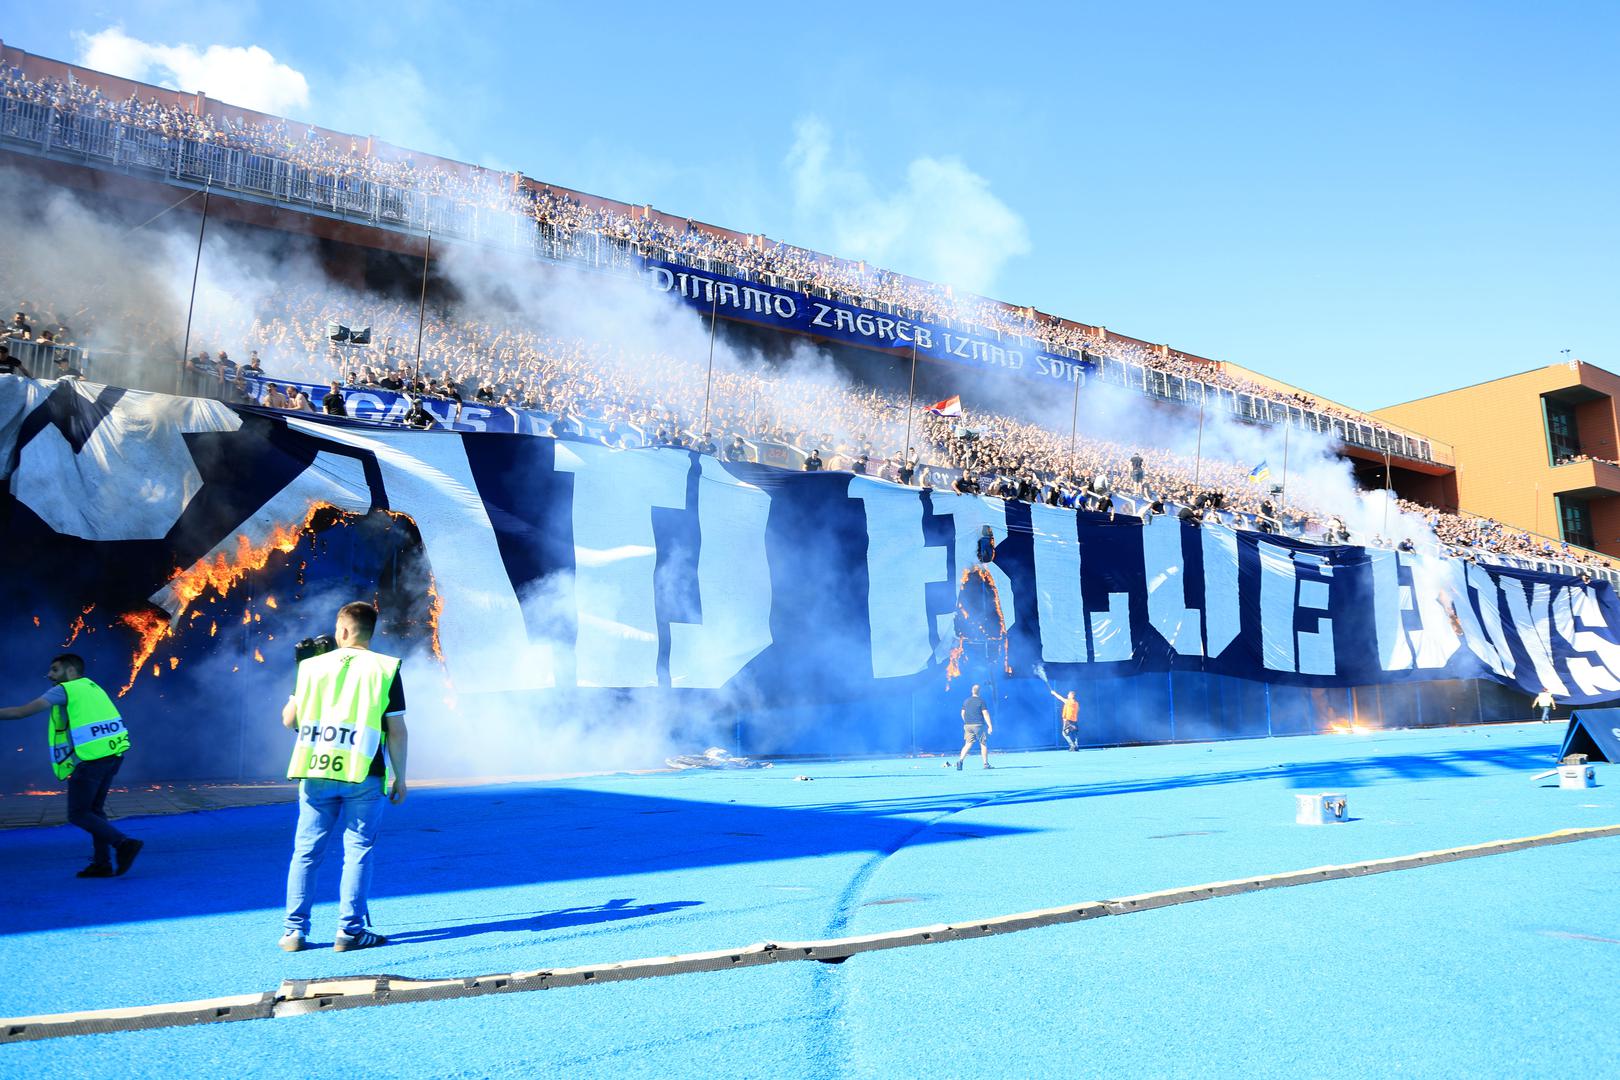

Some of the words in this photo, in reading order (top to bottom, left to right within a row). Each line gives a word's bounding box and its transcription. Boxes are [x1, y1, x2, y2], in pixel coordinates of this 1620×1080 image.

[649, 266, 797, 318] DINAMO
[812, 302, 933, 348] ZAGREB
[942, 333, 1024, 370] IZNAD
[847, 473, 1336, 679] BLUE
[91, 720, 127, 736] PHOT
[309, 754, 344, 772] 096
